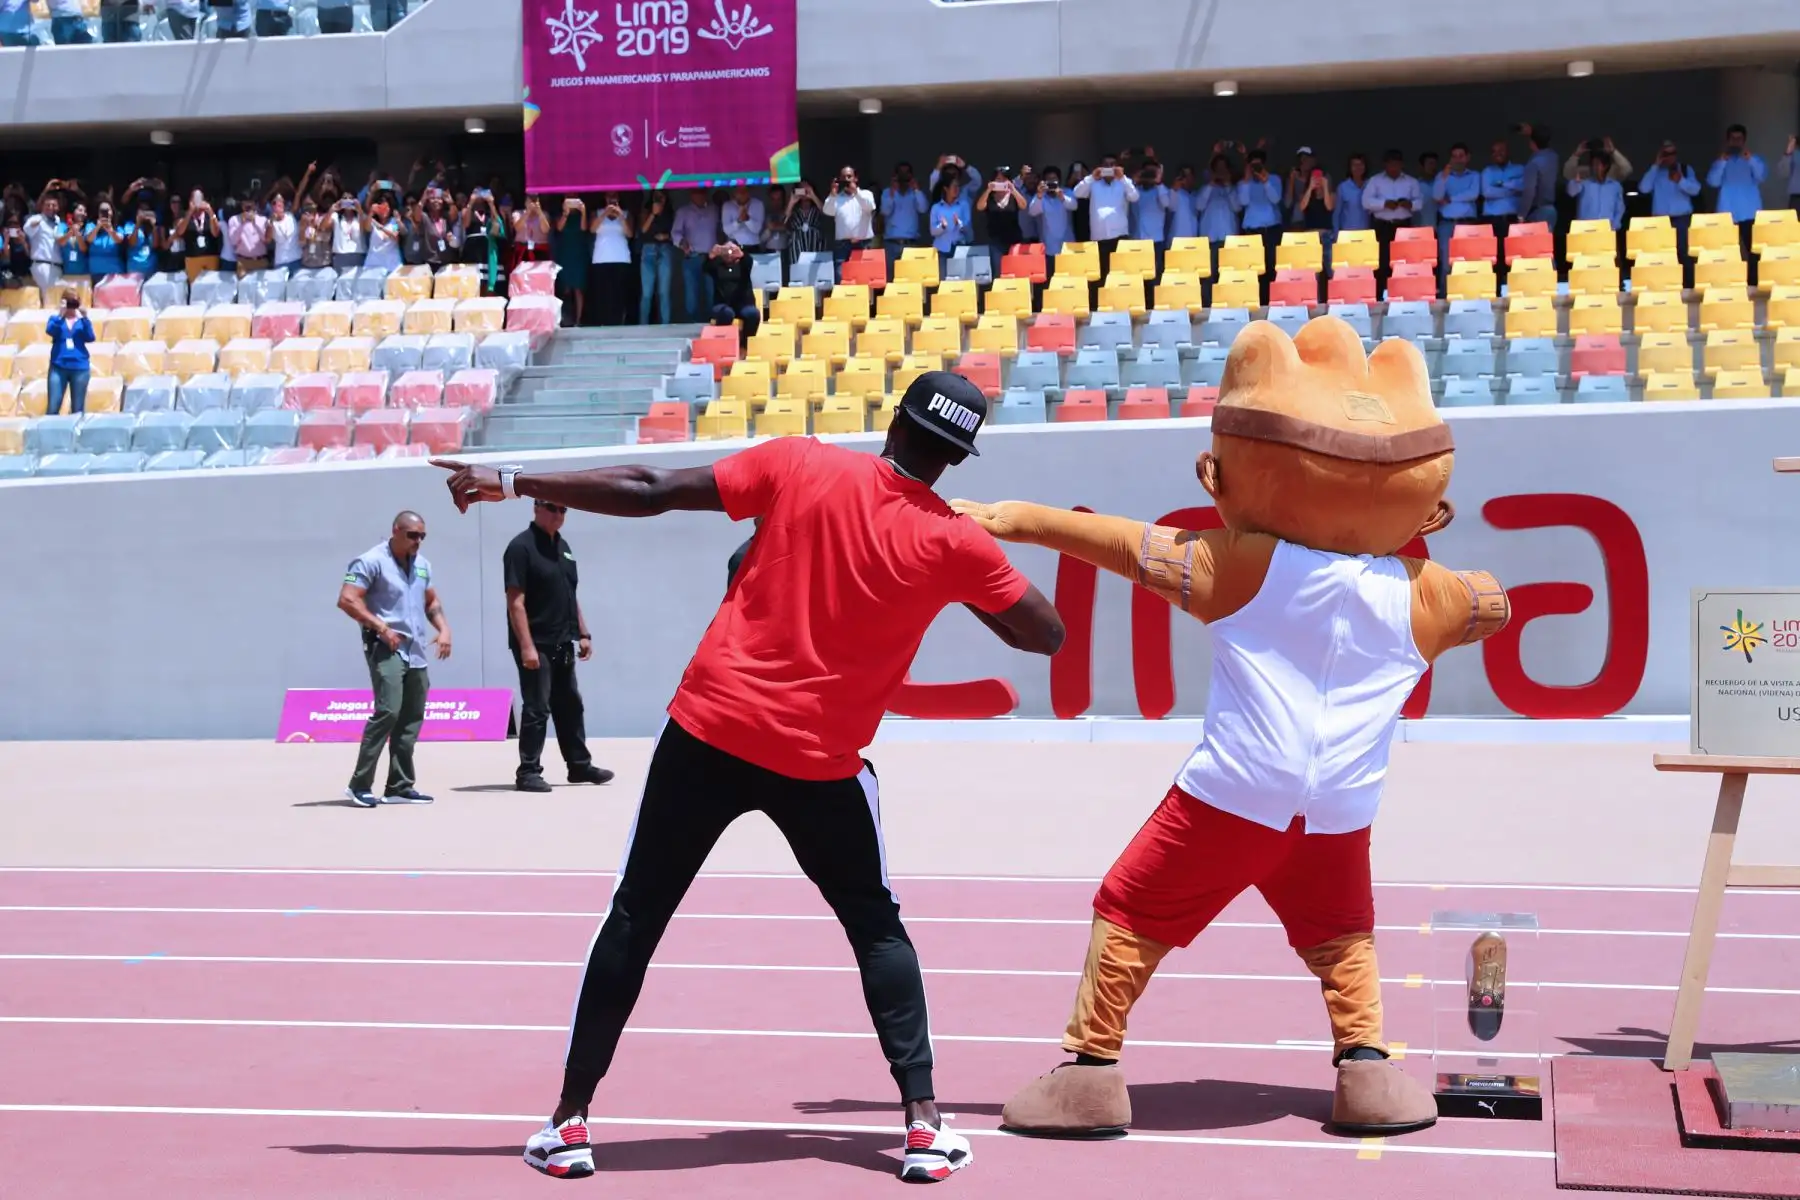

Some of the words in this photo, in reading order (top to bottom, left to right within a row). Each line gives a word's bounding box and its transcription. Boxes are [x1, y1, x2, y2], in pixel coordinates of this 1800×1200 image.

[617, 26, 689, 57] 2019
[551, 76, 583, 88] JUEGOS
[585, 73, 662, 86] PANAMERICANOS
[663, 73, 669, 82] Y
[670, 67, 770, 81] PARAPANAMERICANOS
[927, 392, 980, 433] PUMA
[327, 701, 368, 711] Juegos
[458, 701, 467, 711] y
[452, 710, 481, 720] 2019
